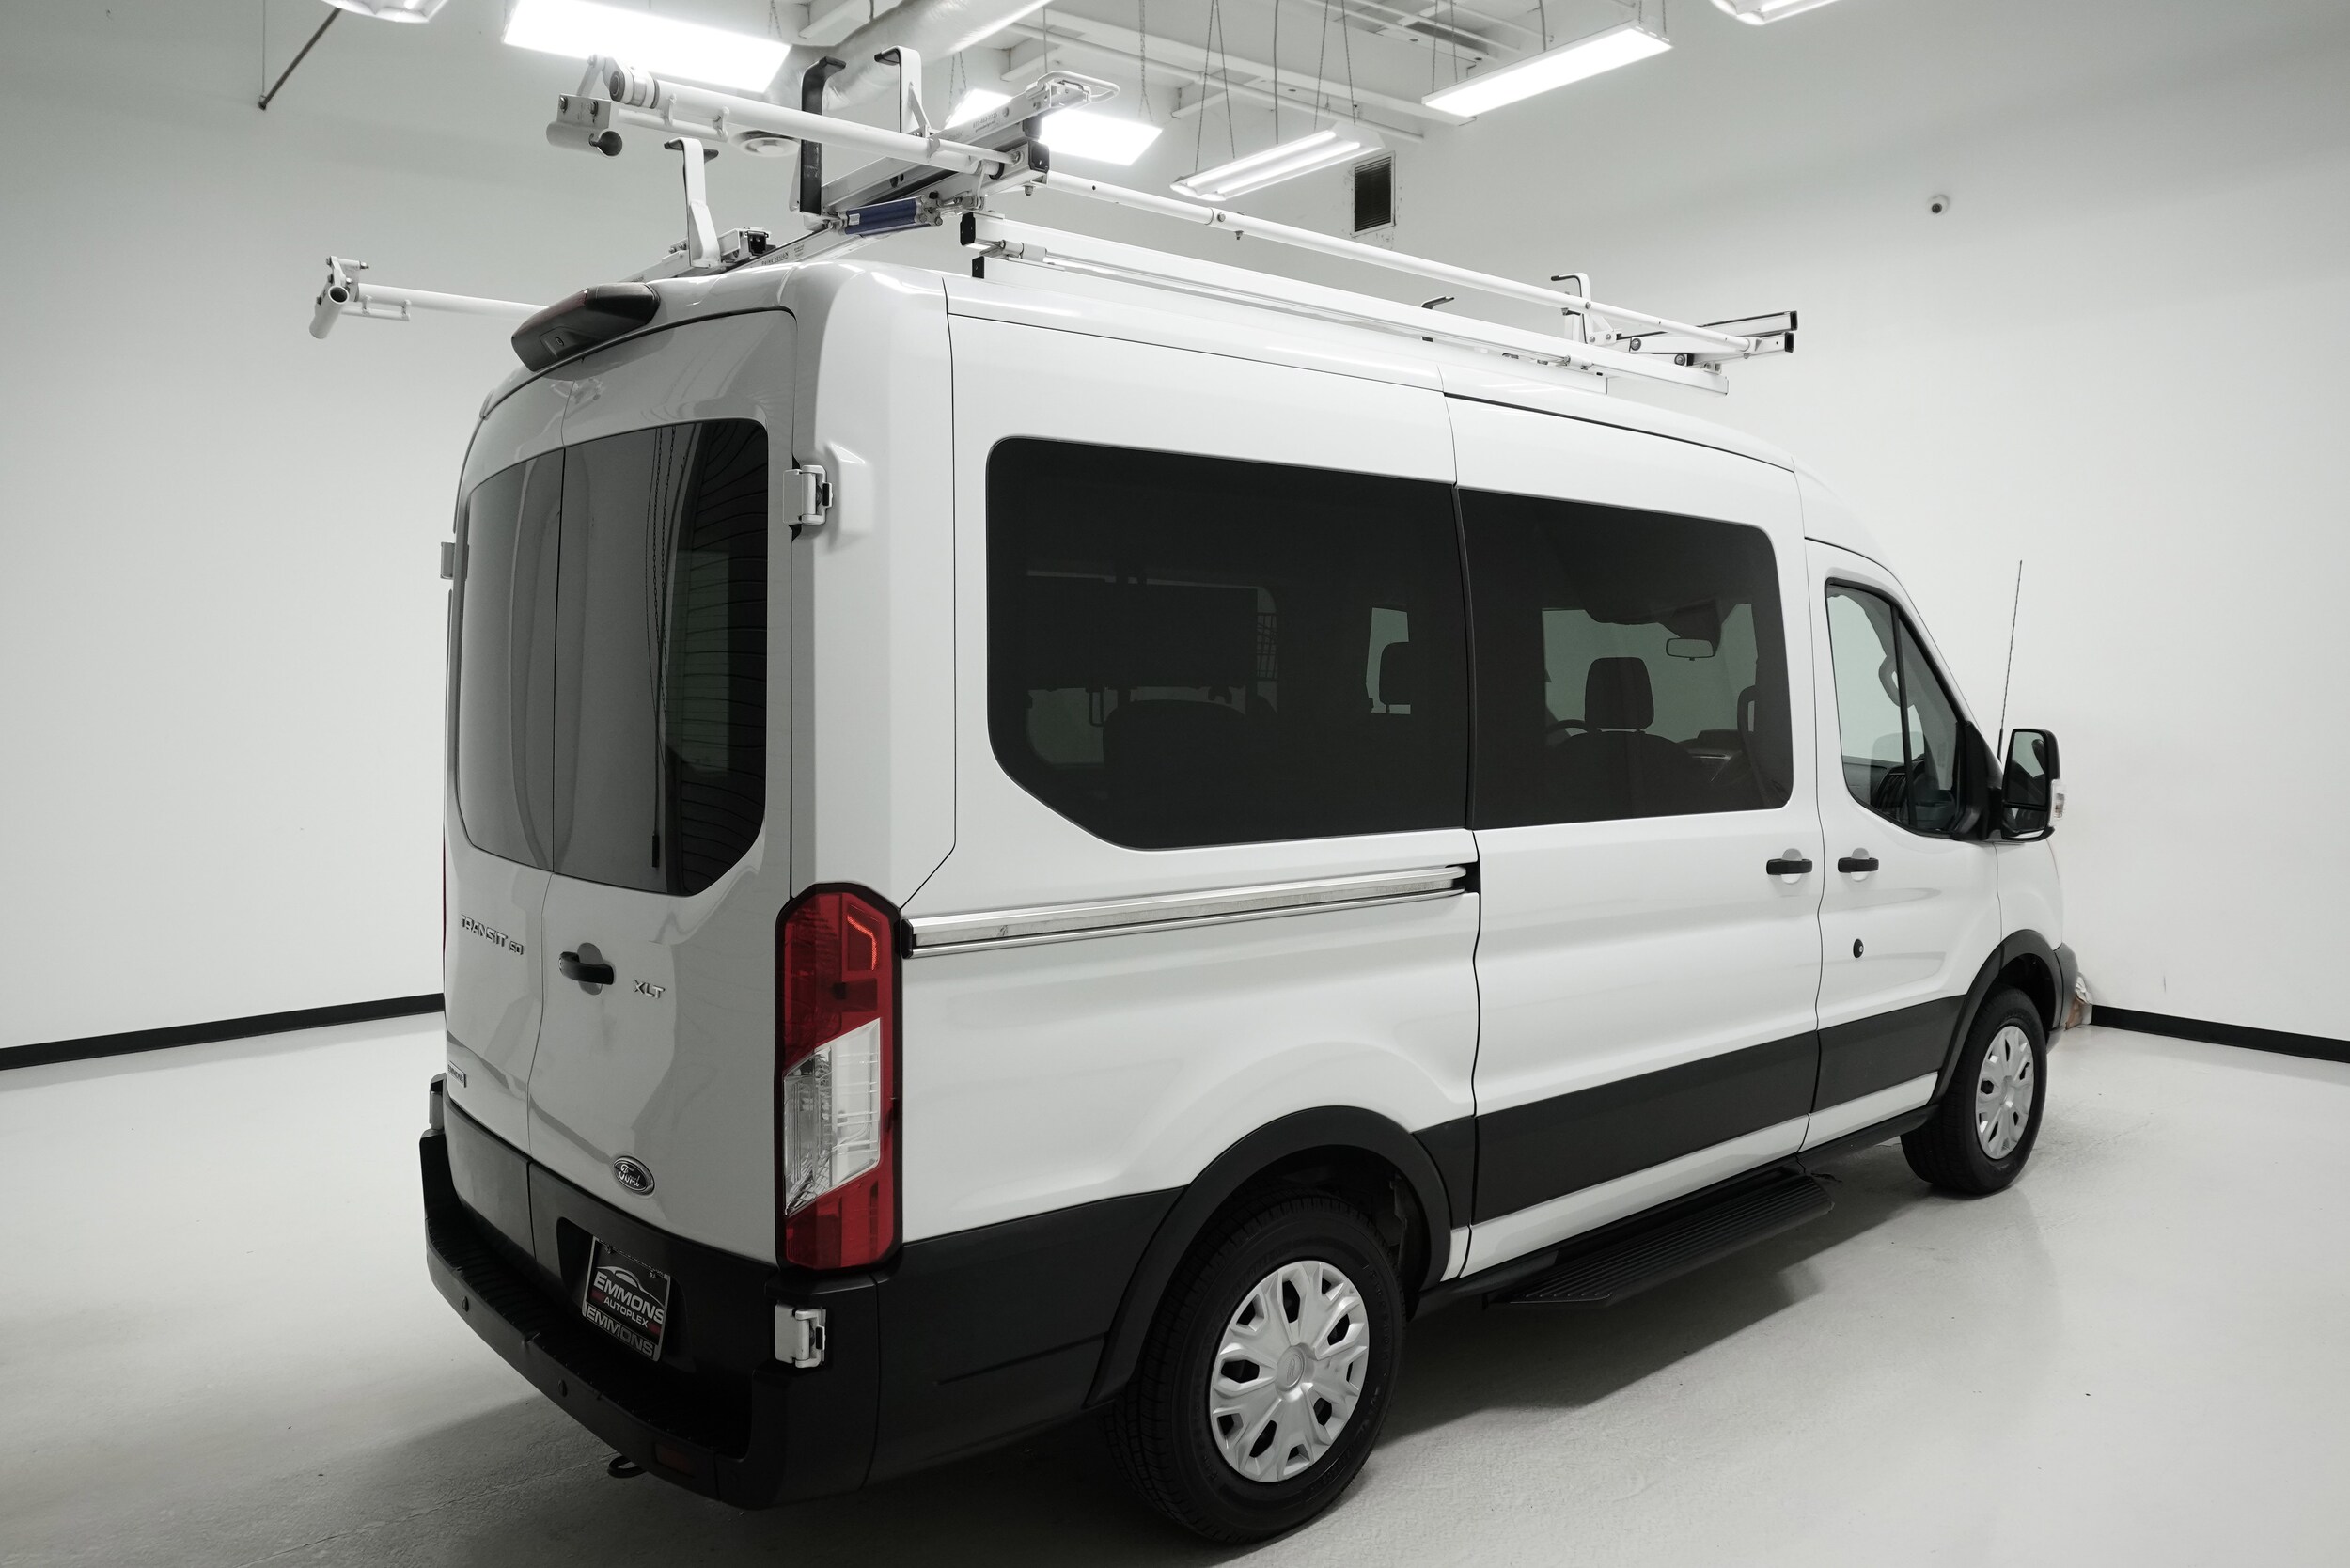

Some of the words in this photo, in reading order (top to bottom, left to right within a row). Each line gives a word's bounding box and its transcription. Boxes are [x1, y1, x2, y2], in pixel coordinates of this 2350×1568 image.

[461, 914, 509, 947] TRANSIT
[634, 980, 666, 999] XLT
[619, 1164, 640, 1187] Ford
[593, 1270, 665, 1325] EMMONS
[603, 1295, 649, 1328] AUTOPLEX
[587, 1308, 654, 1358] EMMONS
